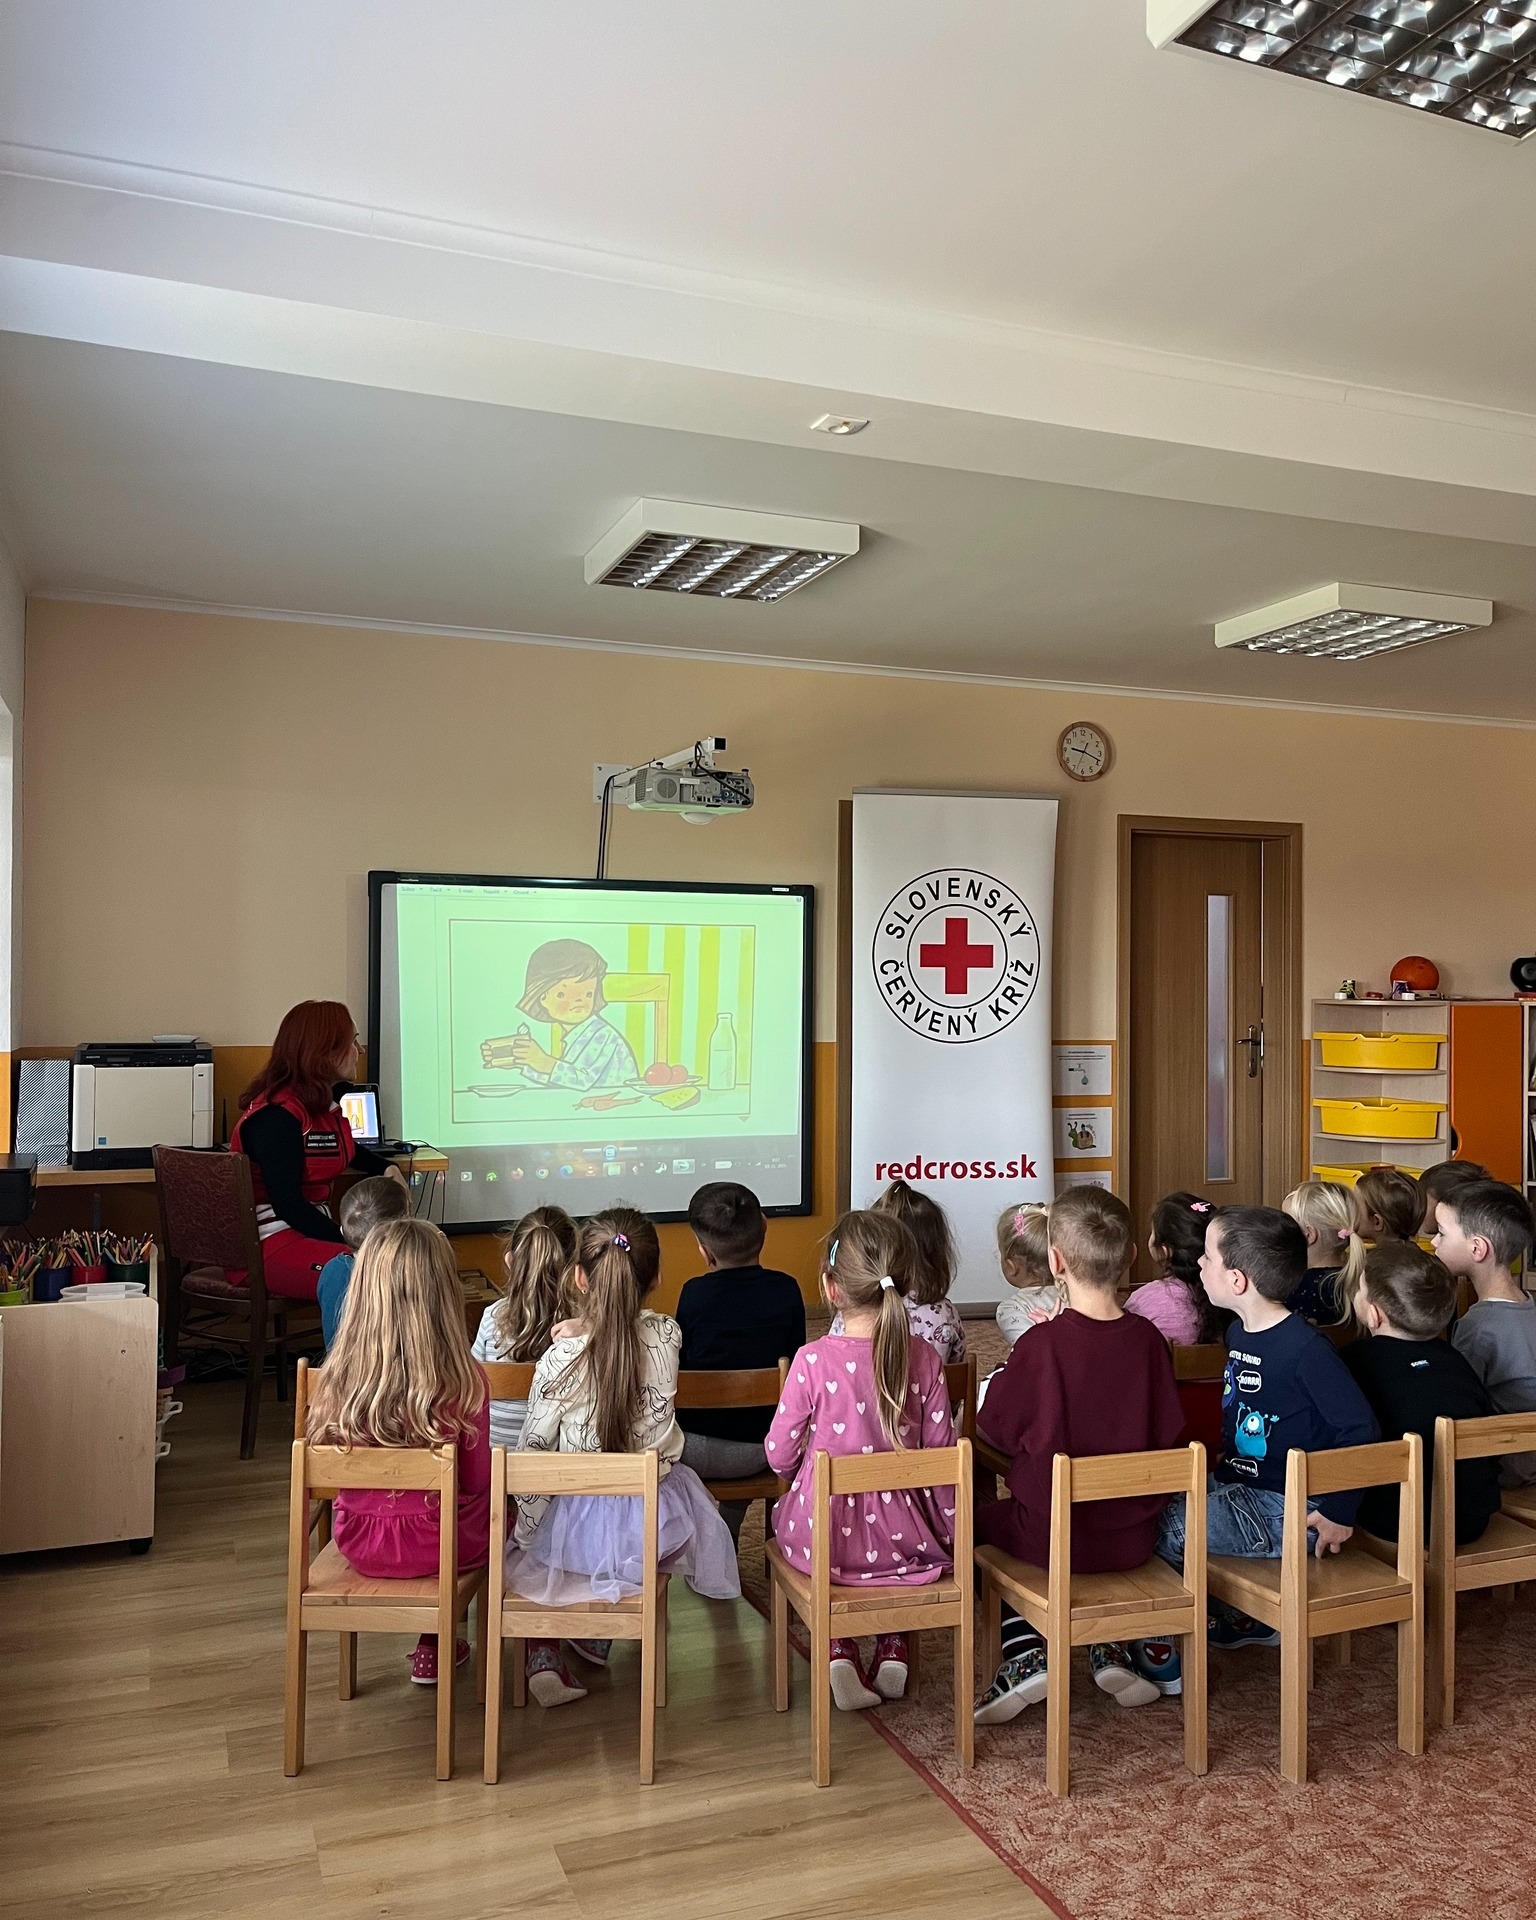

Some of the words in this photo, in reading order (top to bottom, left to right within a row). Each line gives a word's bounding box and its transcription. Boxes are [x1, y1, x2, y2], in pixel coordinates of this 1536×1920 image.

[886, 878, 1032, 939] SLOVENSKÝ
[880, 960, 978, 1036] ČERVENÝ
[988, 960, 1035, 1022] KRÍŽ
[876, 1155, 1037, 1180] redcross.sk
